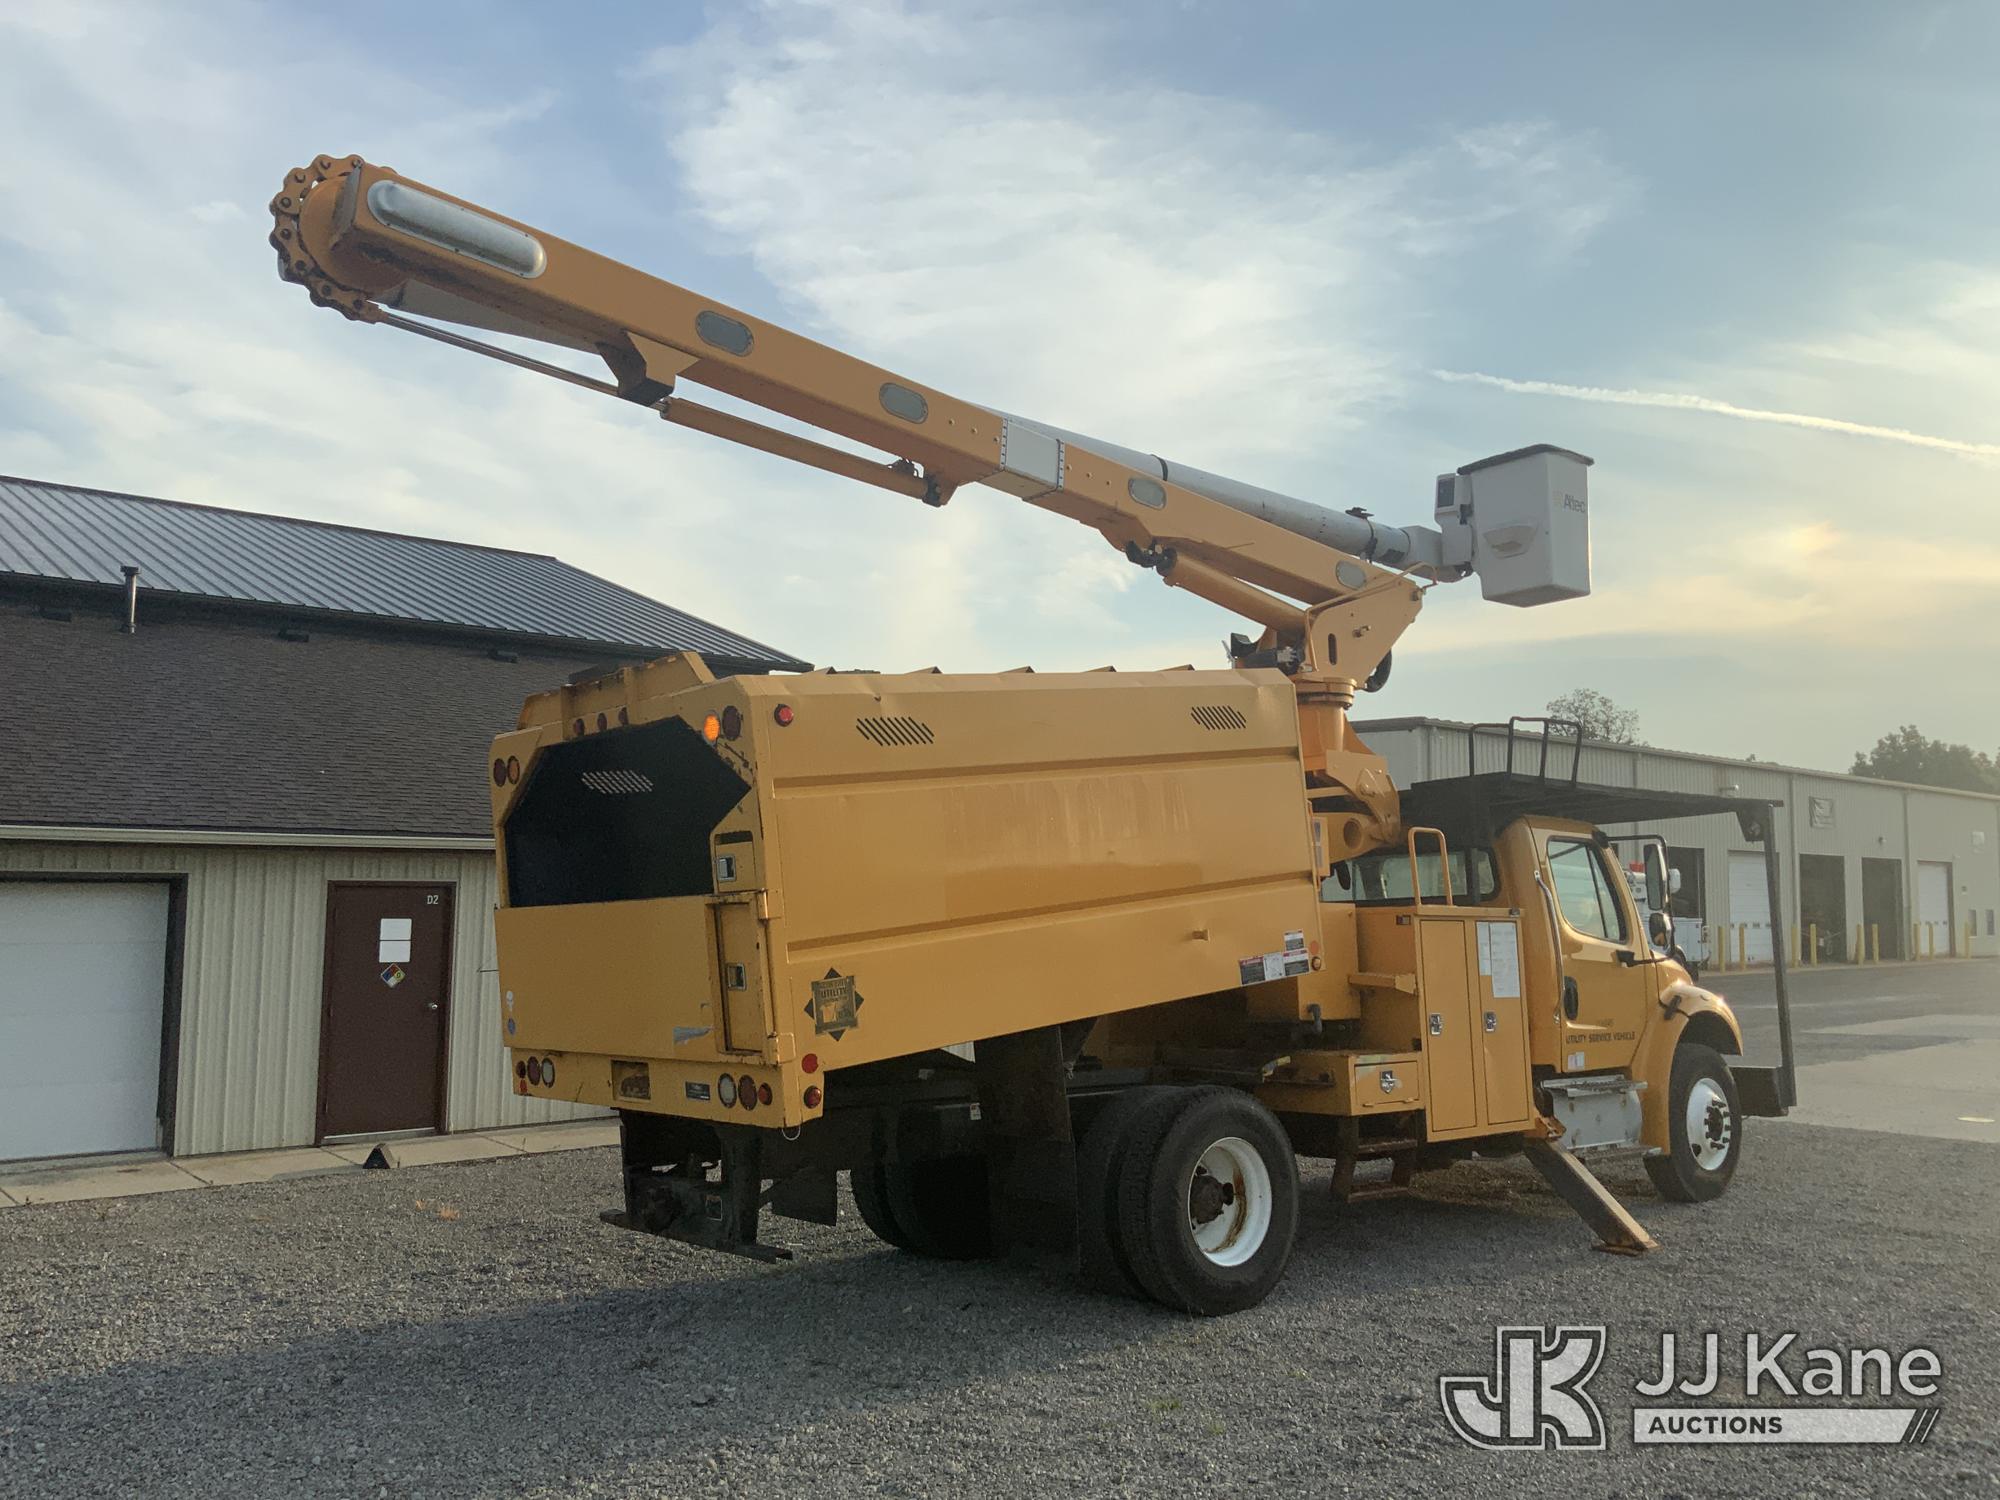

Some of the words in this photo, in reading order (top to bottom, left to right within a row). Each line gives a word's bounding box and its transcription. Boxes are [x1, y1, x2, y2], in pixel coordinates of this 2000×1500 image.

[1564, 494, 1586, 513] Altec
[427, 895, 439, 905] D2
[820, 987, 848, 998] UTILITY
[1566, 1034, 1586, 1044] UTILITY
[1588, 1032, 1612, 1043] SERVICE
[1613, 1031, 1635, 1041] VEHICLE
